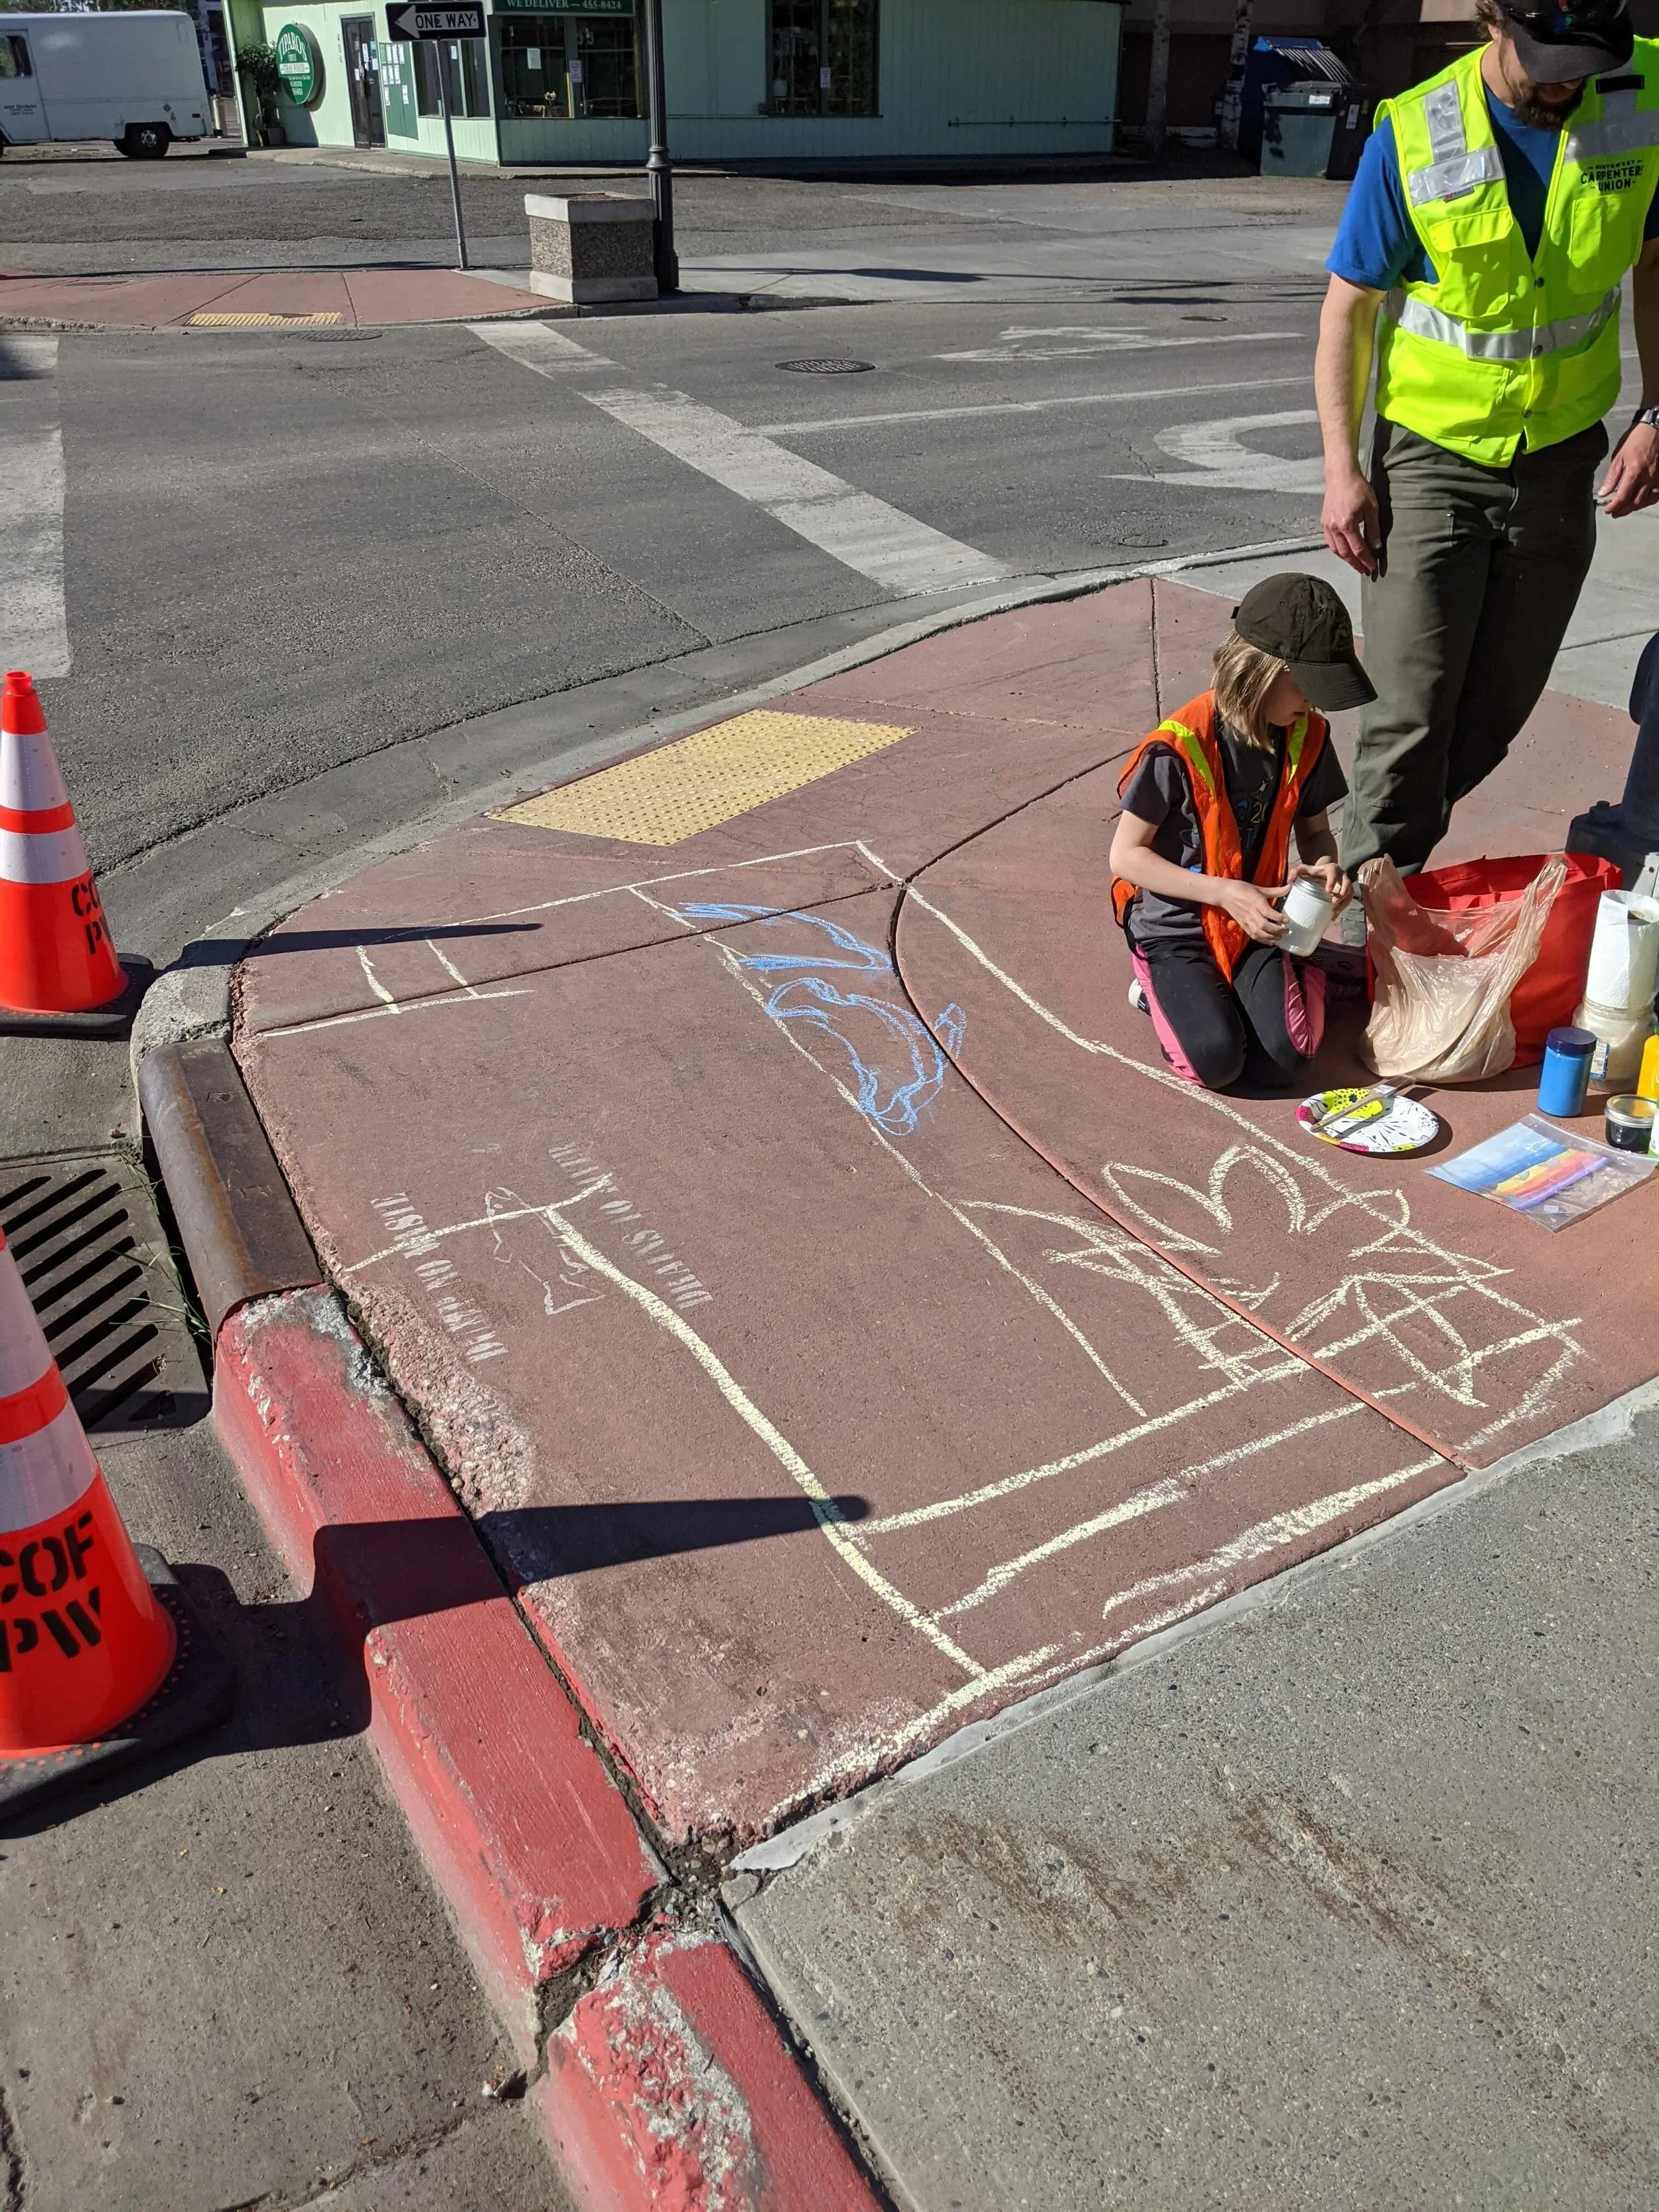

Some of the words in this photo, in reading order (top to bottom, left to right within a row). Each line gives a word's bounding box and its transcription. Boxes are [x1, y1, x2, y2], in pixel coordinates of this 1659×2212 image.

[415, 15, 442, 29] ONE
[446, 13, 473, 27] WAY
[1598, 179, 1631, 192] UNION
[370, 1193, 442, 1259] WASTE
[415, 1260, 462, 1291] NO
[622, 1229, 714, 1310] DRAINS
